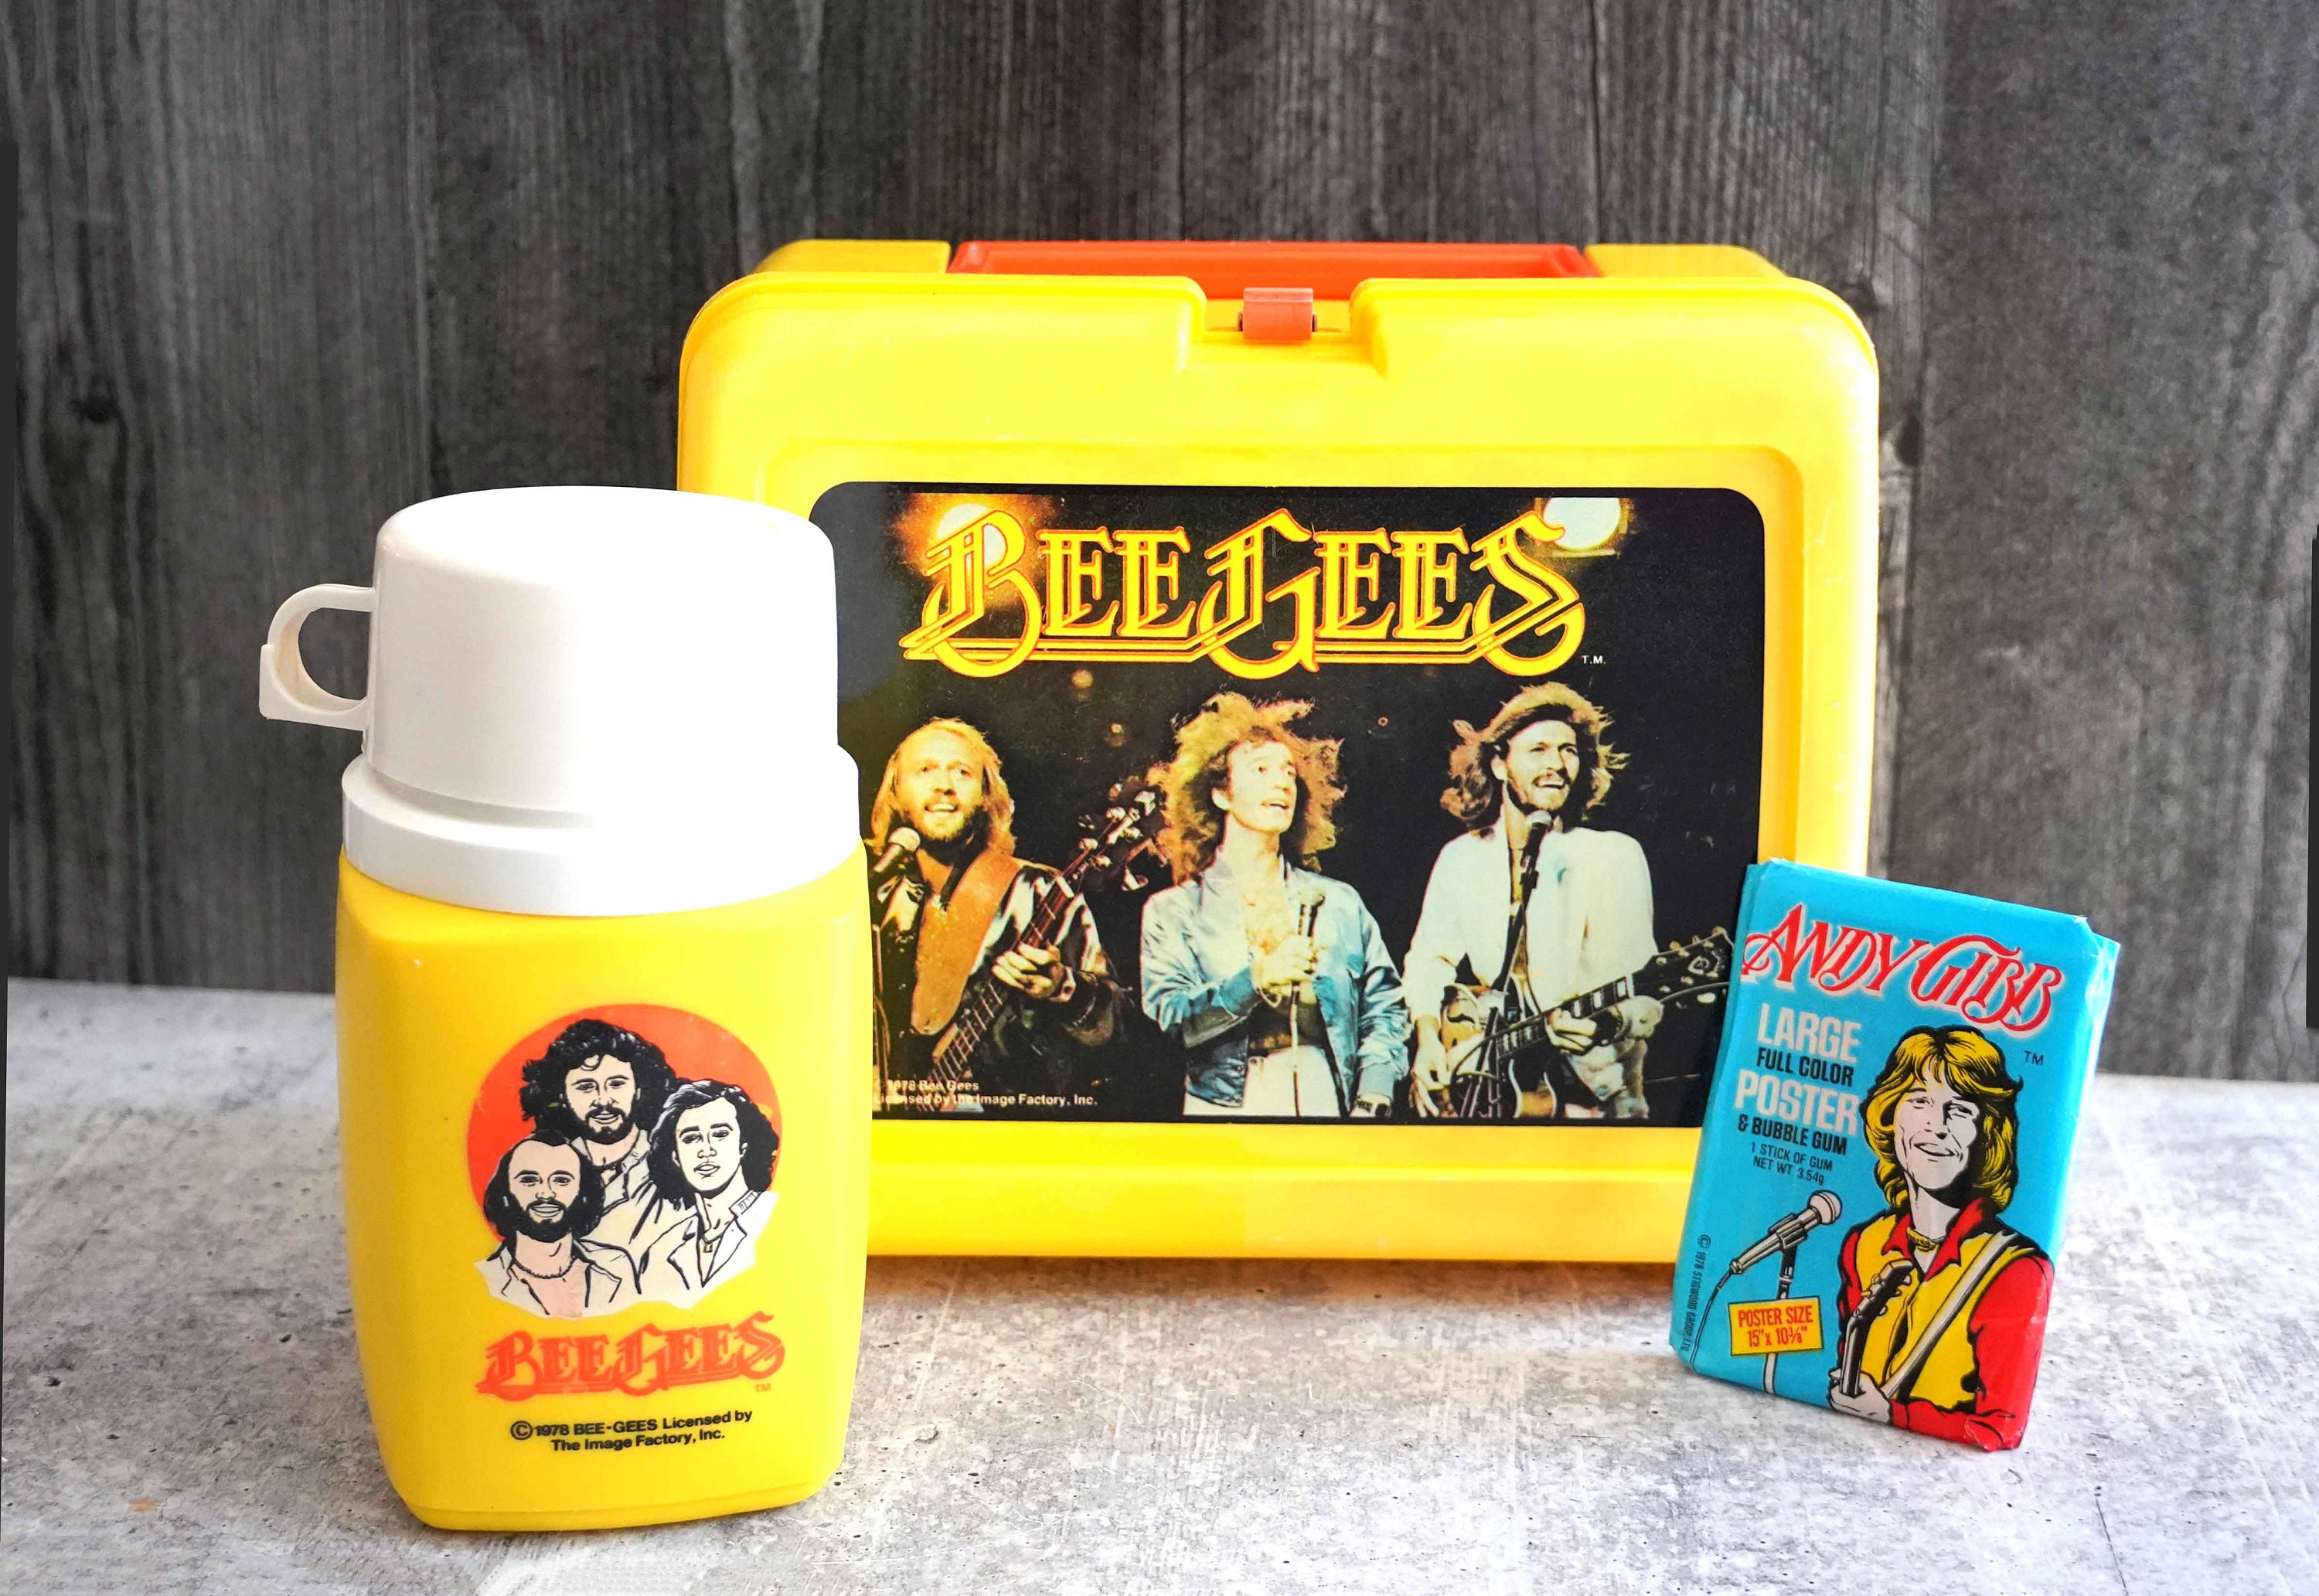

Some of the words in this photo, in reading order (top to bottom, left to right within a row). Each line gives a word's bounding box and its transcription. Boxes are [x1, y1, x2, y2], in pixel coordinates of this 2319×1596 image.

[899, 509, 1197, 679] BEE
[1197, 507, 1585, 678] GEES
[1582, 655, 1606, 665] T.M.
[1741, 903, 1930, 997] ANDY
[1909, 934, 2063, 1034] GIBB
[1757, 1003, 1861, 1063] LARGE
[1756, 1046, 1796, 1075] FULL
[1799, 1056, 1854, 1087] COLOR
[2024, 1050, 2044, 1066] TM
[945, 1079, 979, 1092] Gees
[976, 1093, 1016, 1108] Image
[1074, 1094, 1098, 1105] Inc.
[1734, 1070, 1859, 1135] POSTER
[1738, 1114, 1749, 1131] &
[1752, 1117, 1809, 1147] BUBBLE
[1811, 1131, 1848, 1155] GUM
[1752, 1142, 1755, 1152] 1
[1760, 1143, 1790, 1162] STICK
[1793, 1152, 1807, 1164] OF
[1809, 1156, 1833, 1171] GUM
[1753, 1155, 1774, 1170] NET
[1797, 1168, 1825, 1186] 3.54g
[1694, 1251, 1707, 1269] 1978
[1738, 1307, 1783, 1328] POSTER
[1786, 1305, 1813, 1324] SIZE
[474, 1330, 612, 1402] BEE
[616, 1310, 786, 1397] GEES
[574, 1419, 658, 1435] BEE-GEES
[662, 1411, 731, 1429] Licensed
[734, 1410, 753, 1423] by
[550, 1438, 581, 1451] The
[584, 1438, 633, 1451] Image
[635, 1433, 696, 1447] Factory,
[700, 1428, 725, 1441] Inc.
